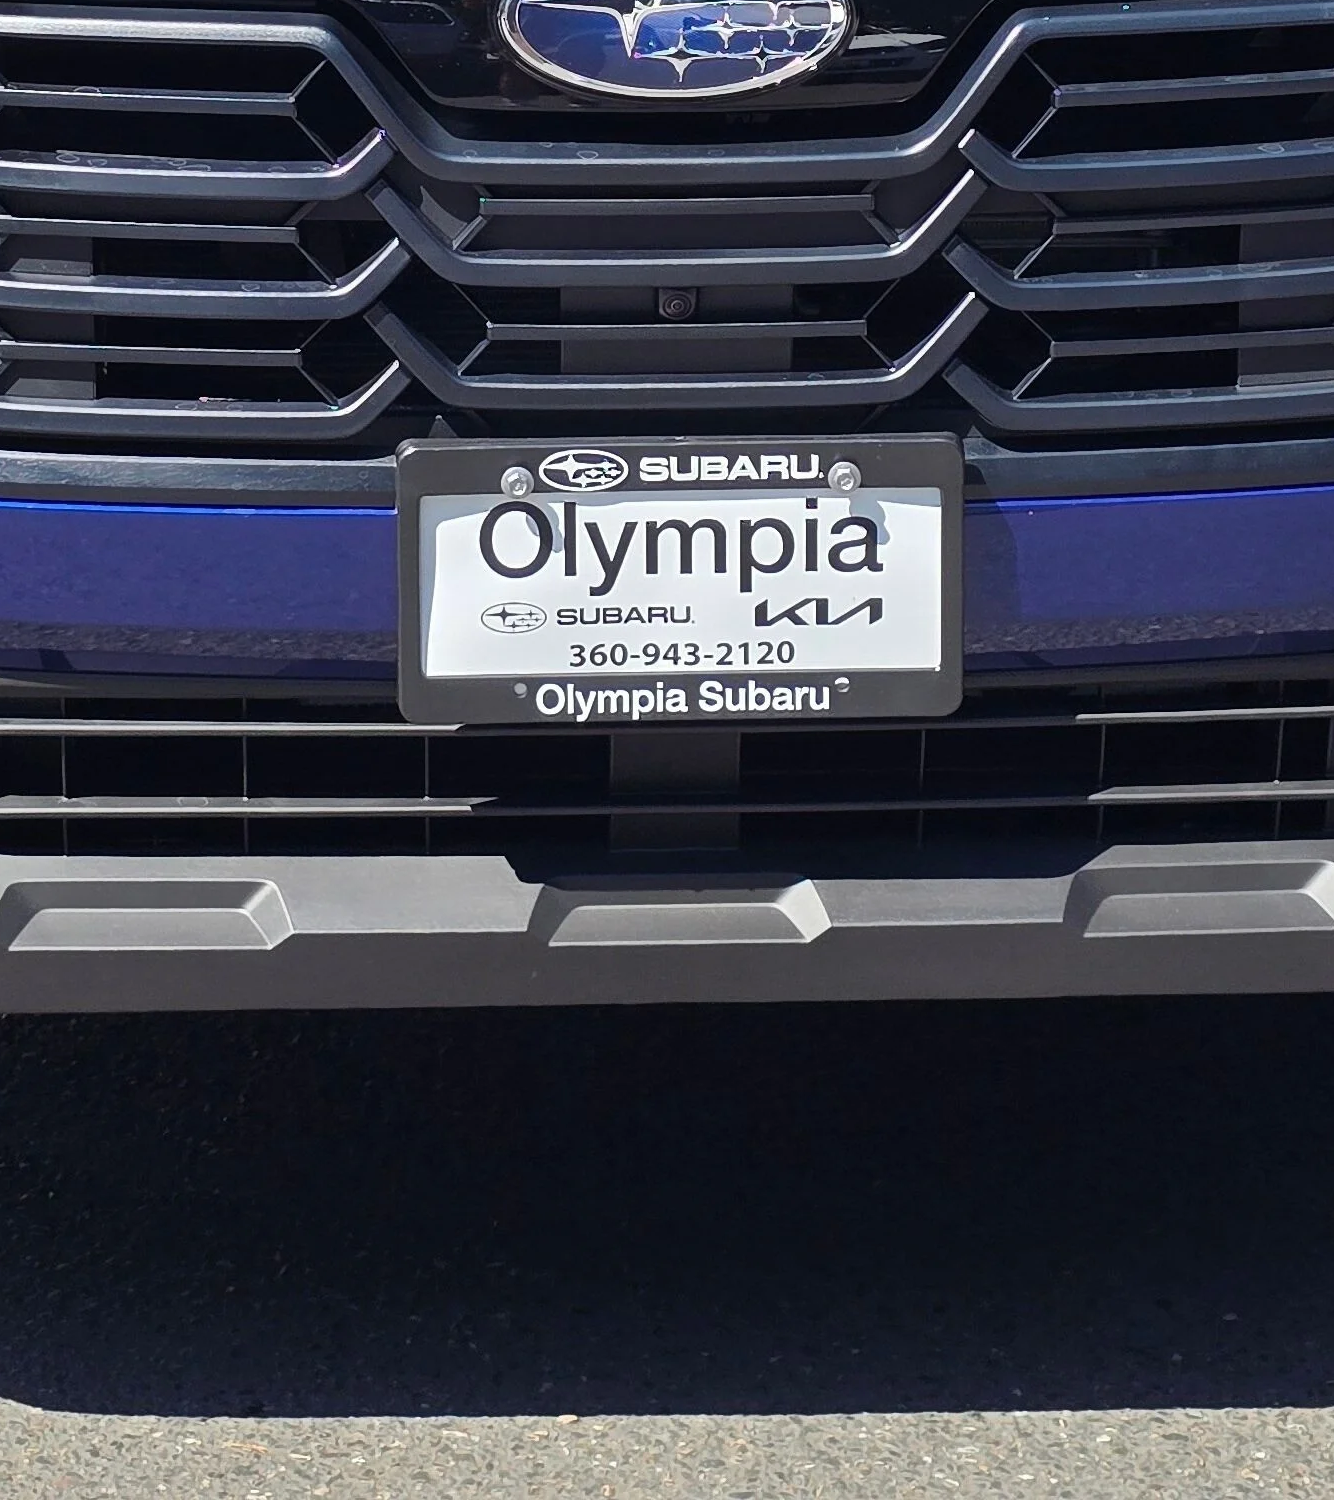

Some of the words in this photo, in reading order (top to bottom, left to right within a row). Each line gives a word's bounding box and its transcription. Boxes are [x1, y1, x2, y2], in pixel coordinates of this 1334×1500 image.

[480, 498, 883, 596] Olympia
[570, 641, 795, 667] 360-943-2120
[536, 681, 688, 722] Olympia
[699, 680, 829, 713] Subaru
